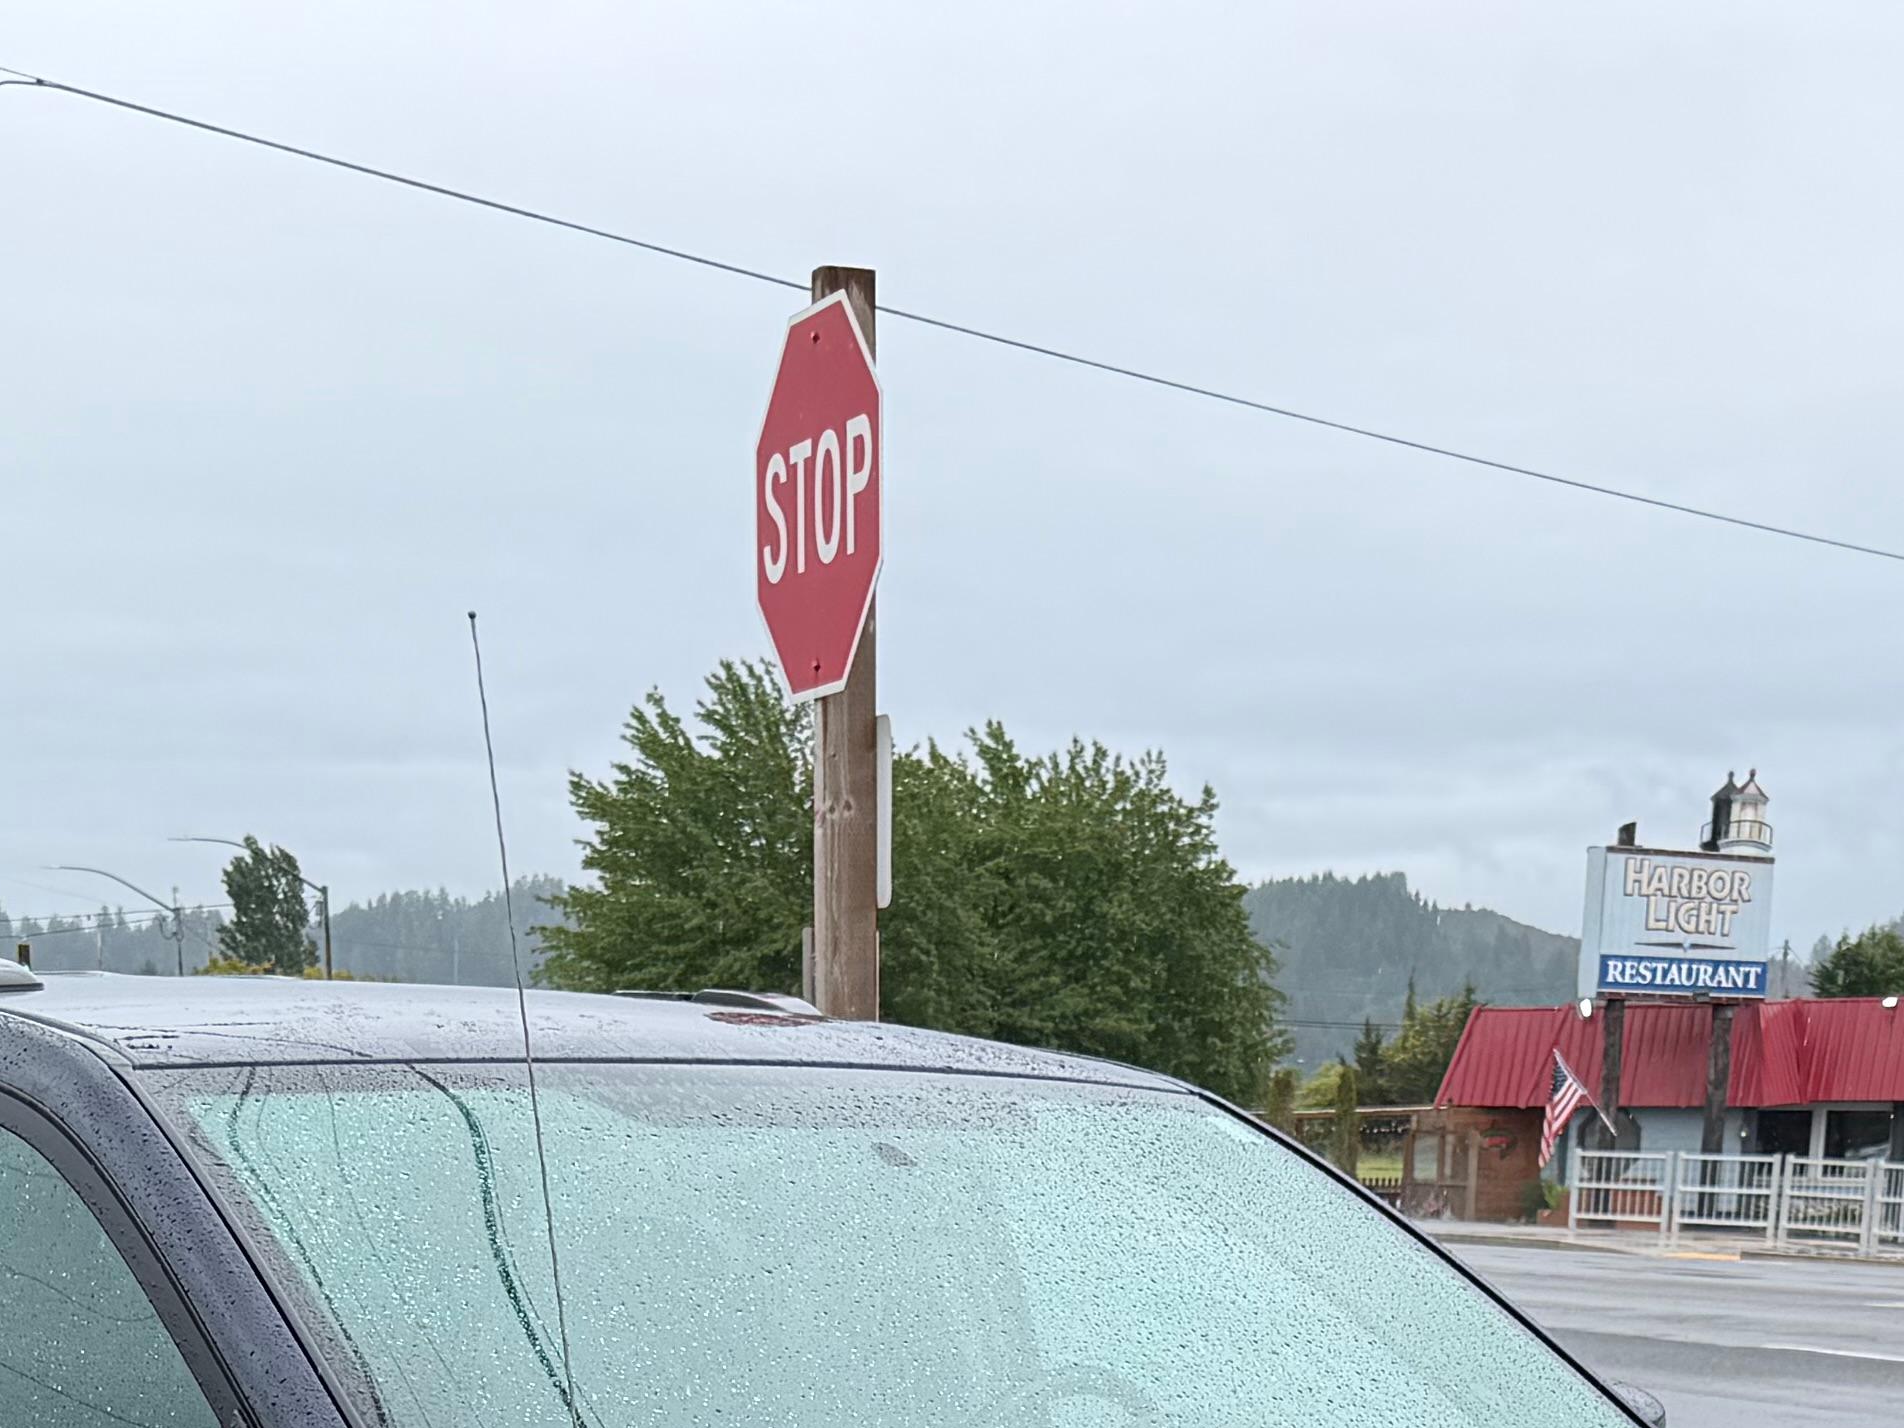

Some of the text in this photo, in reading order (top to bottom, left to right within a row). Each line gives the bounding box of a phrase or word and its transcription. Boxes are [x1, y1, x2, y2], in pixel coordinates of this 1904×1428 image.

[763, 413, 873, 585] STOP
[1624, 856, 1752, 903] HARBOR
[1645, 895, 1739, 937] LIGHT
[1605, 960, 1762, 989] RESTAURANT
